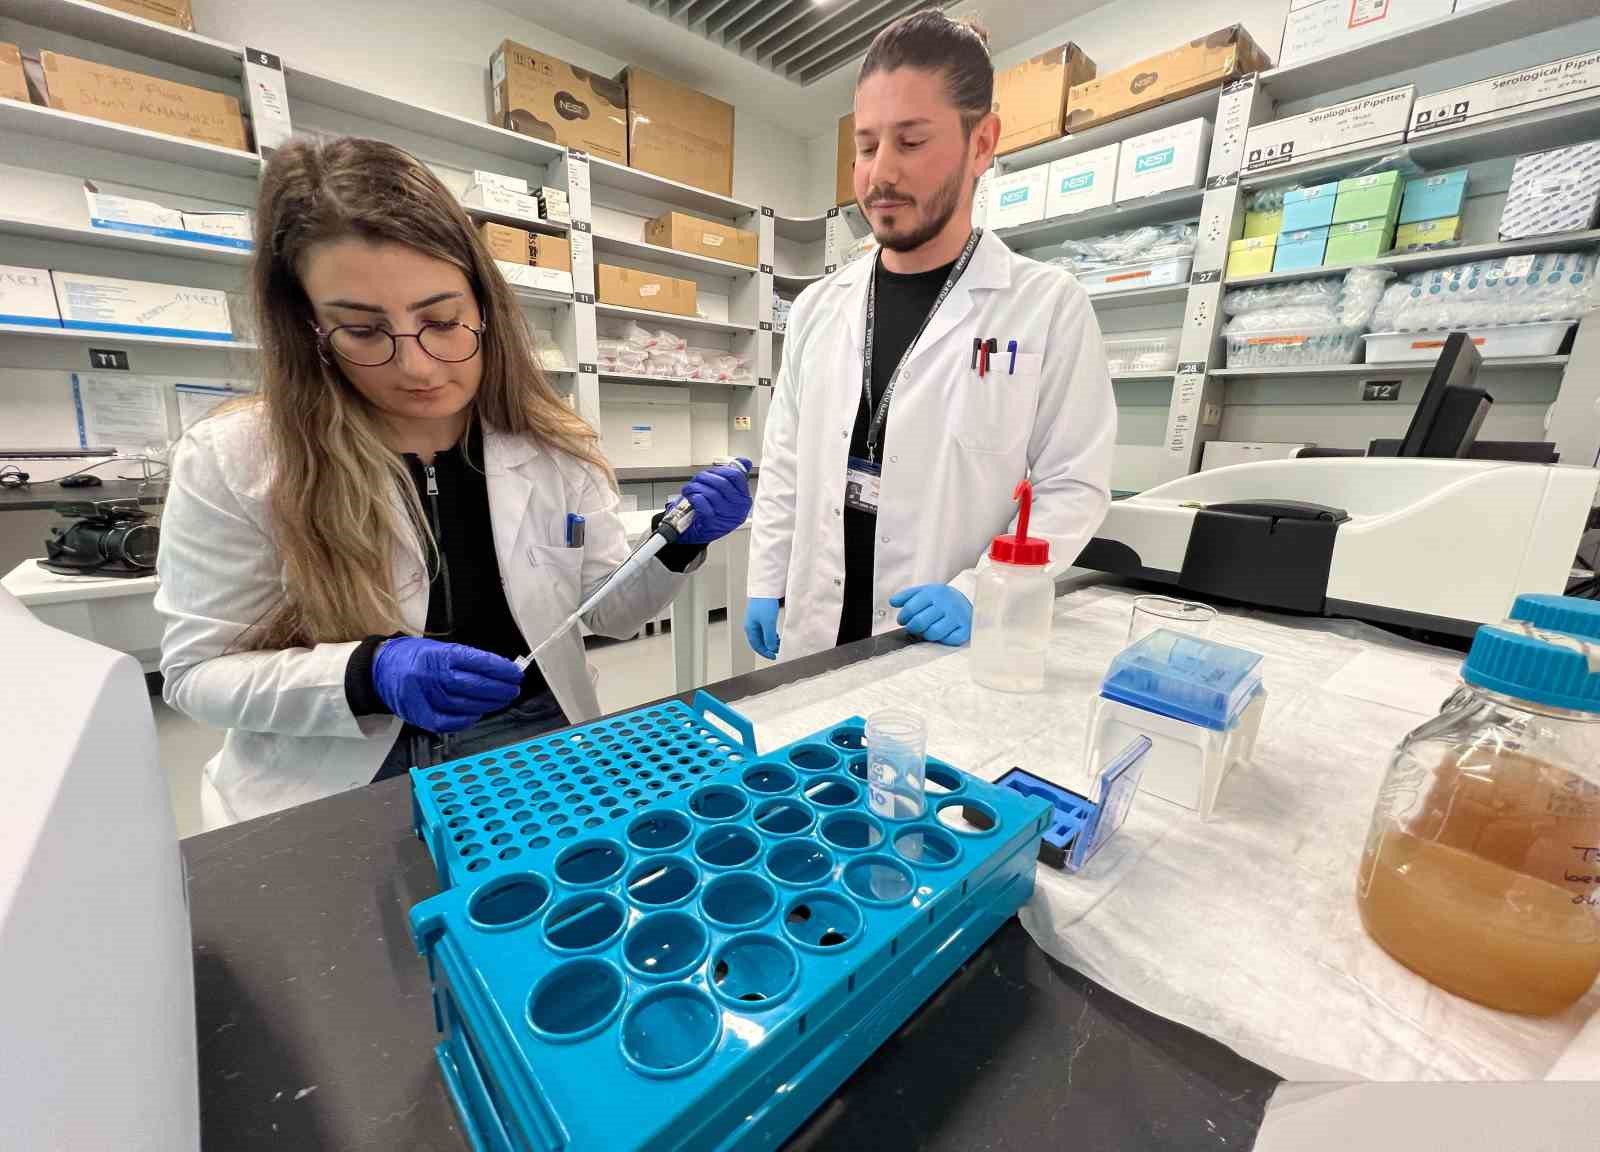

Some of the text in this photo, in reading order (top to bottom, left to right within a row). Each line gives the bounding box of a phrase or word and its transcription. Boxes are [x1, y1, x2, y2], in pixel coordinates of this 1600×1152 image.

[259, 54, 268, 64] 5
[1491, 64, 1562, 90] Serological
[1309, 102, 1361, 123] Serological
[1363, 92, 1407, 109] Pipettes
[1138, 152, 1169, 169] NEST
[1064, 174, 1090, 190] NEST
[1215, 175, 1228, 187] 26
[1001, 190, 1026, 206] NEST
[1200, 272, 1212, 281] 27
[98, 353, 118, 367] T1
[1372, 385, 1392, 397] T2
